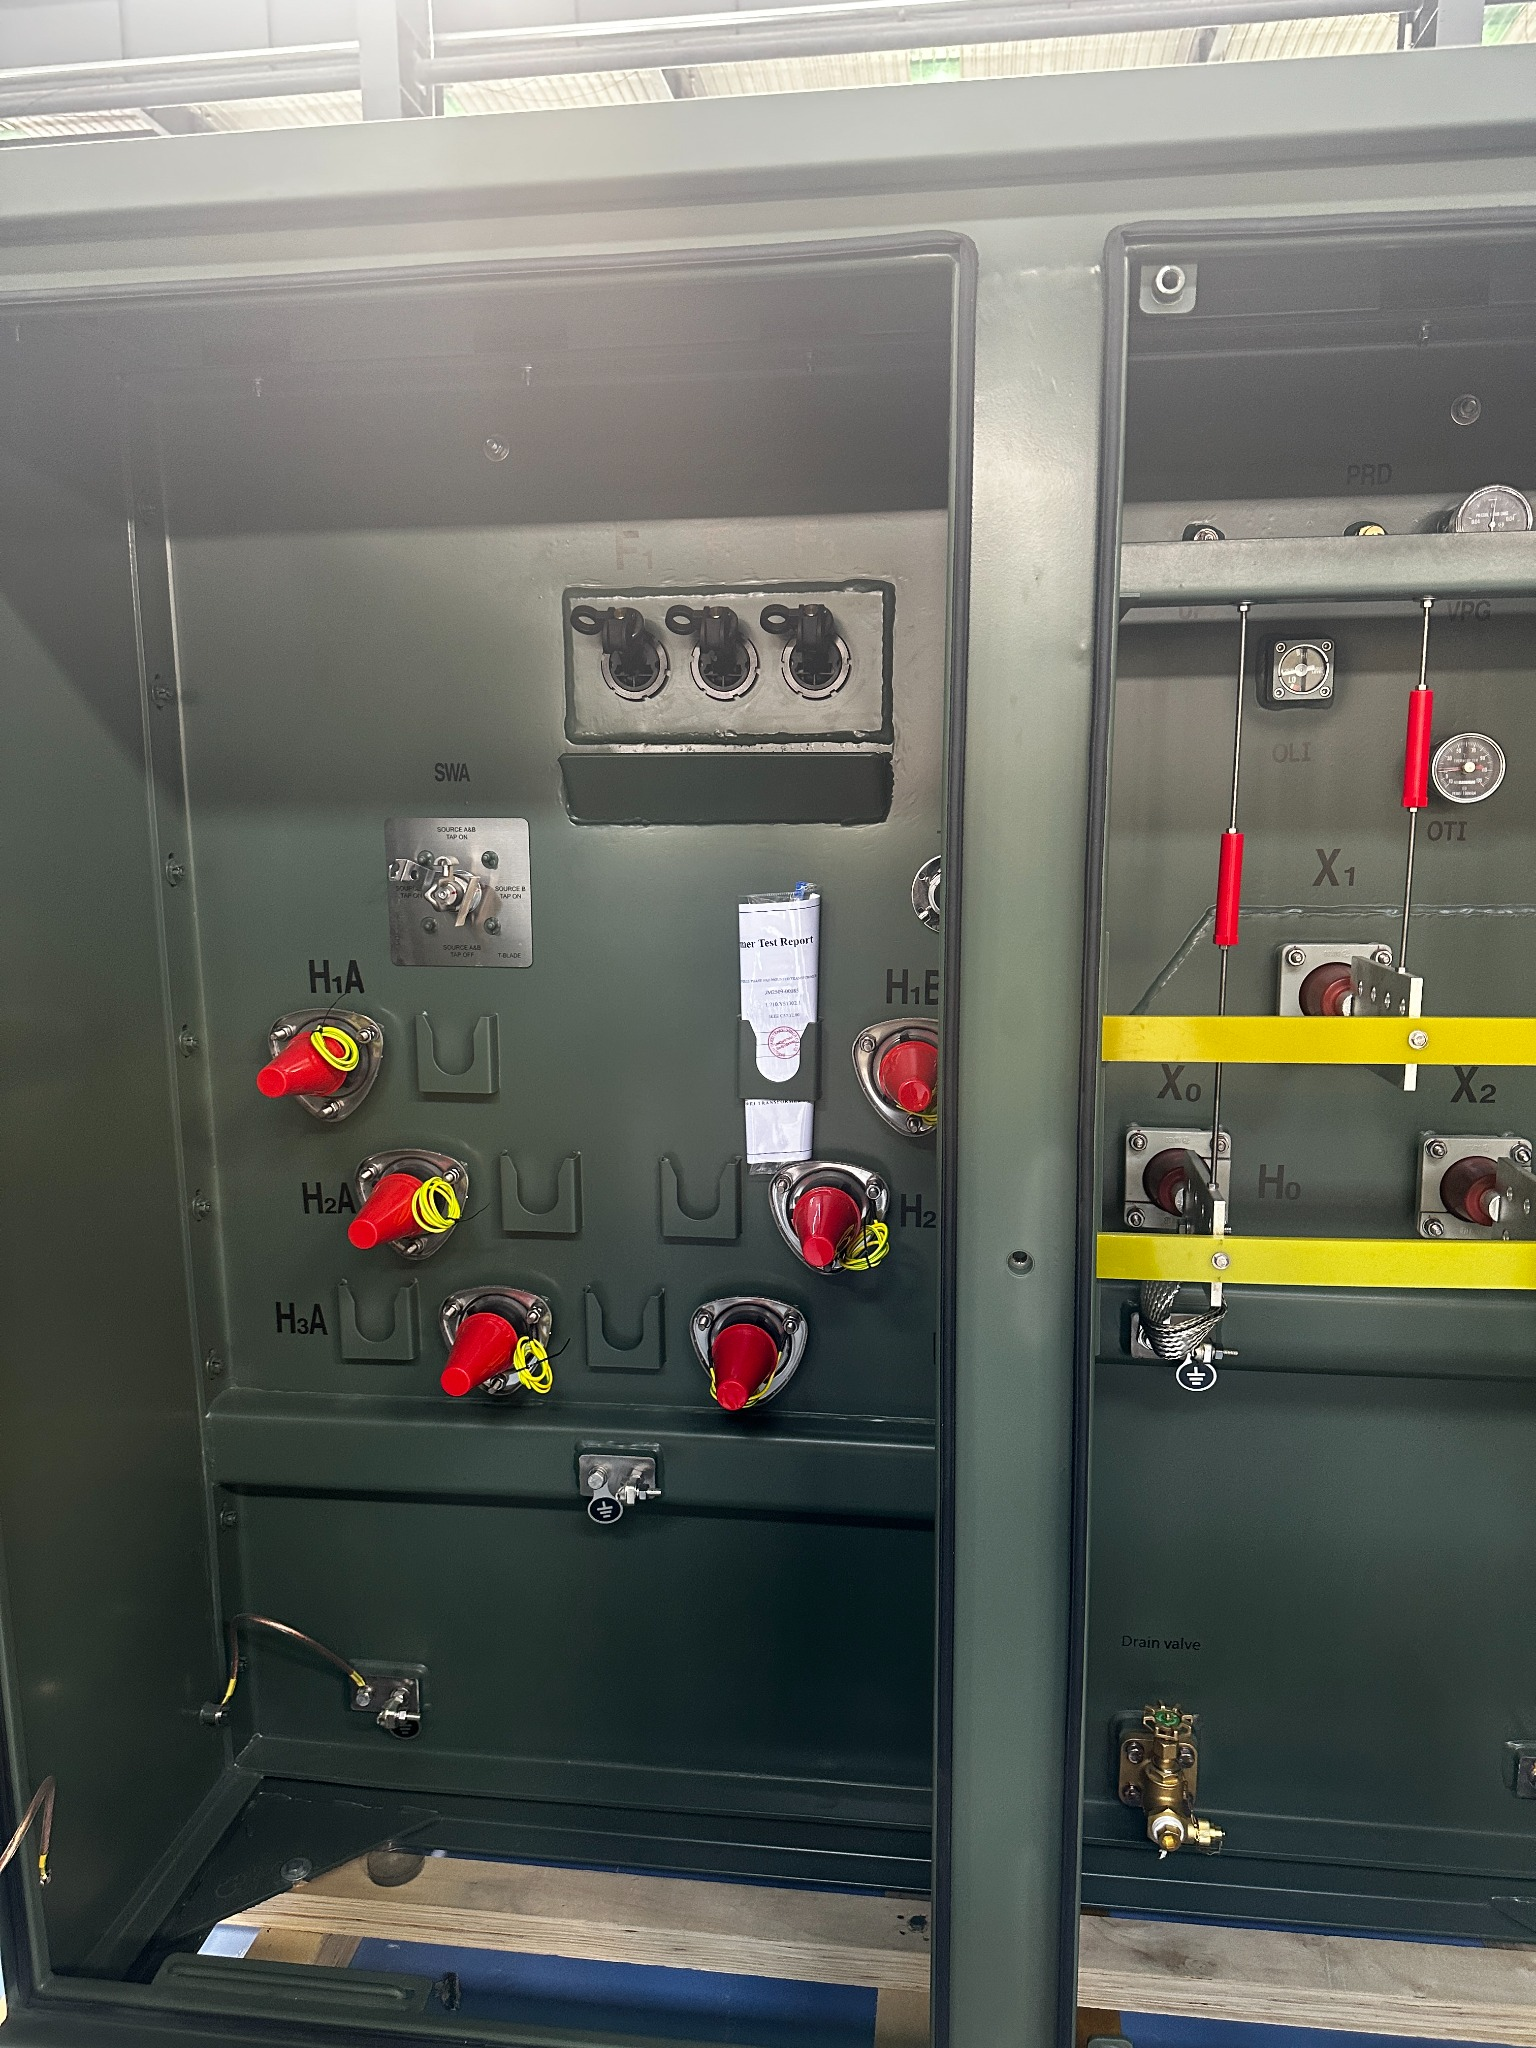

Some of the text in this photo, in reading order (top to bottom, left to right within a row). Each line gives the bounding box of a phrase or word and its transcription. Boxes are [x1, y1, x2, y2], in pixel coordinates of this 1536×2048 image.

[1347, 463, 1392, 485] PRD
[1447, 600, 1492, 621] VPG
[1272, 741, 1311, 763] OLI
[434, 762, 471, 782] SWA
[1427, 820, 1468, 841] OTI
[1312, 848, 1356, 887] X1
[758, 938, 778, 948] Test
[780, 936, 814, 947] Report
[308, 958, 365, 994] H1A
[1449, 1066, 1496, 1104] X2
[302, 1182, 357, 1214] H2A
[275, 1301, 328, 1335] H3A
[1122, 1635, 1201, 1651] Drain valve
